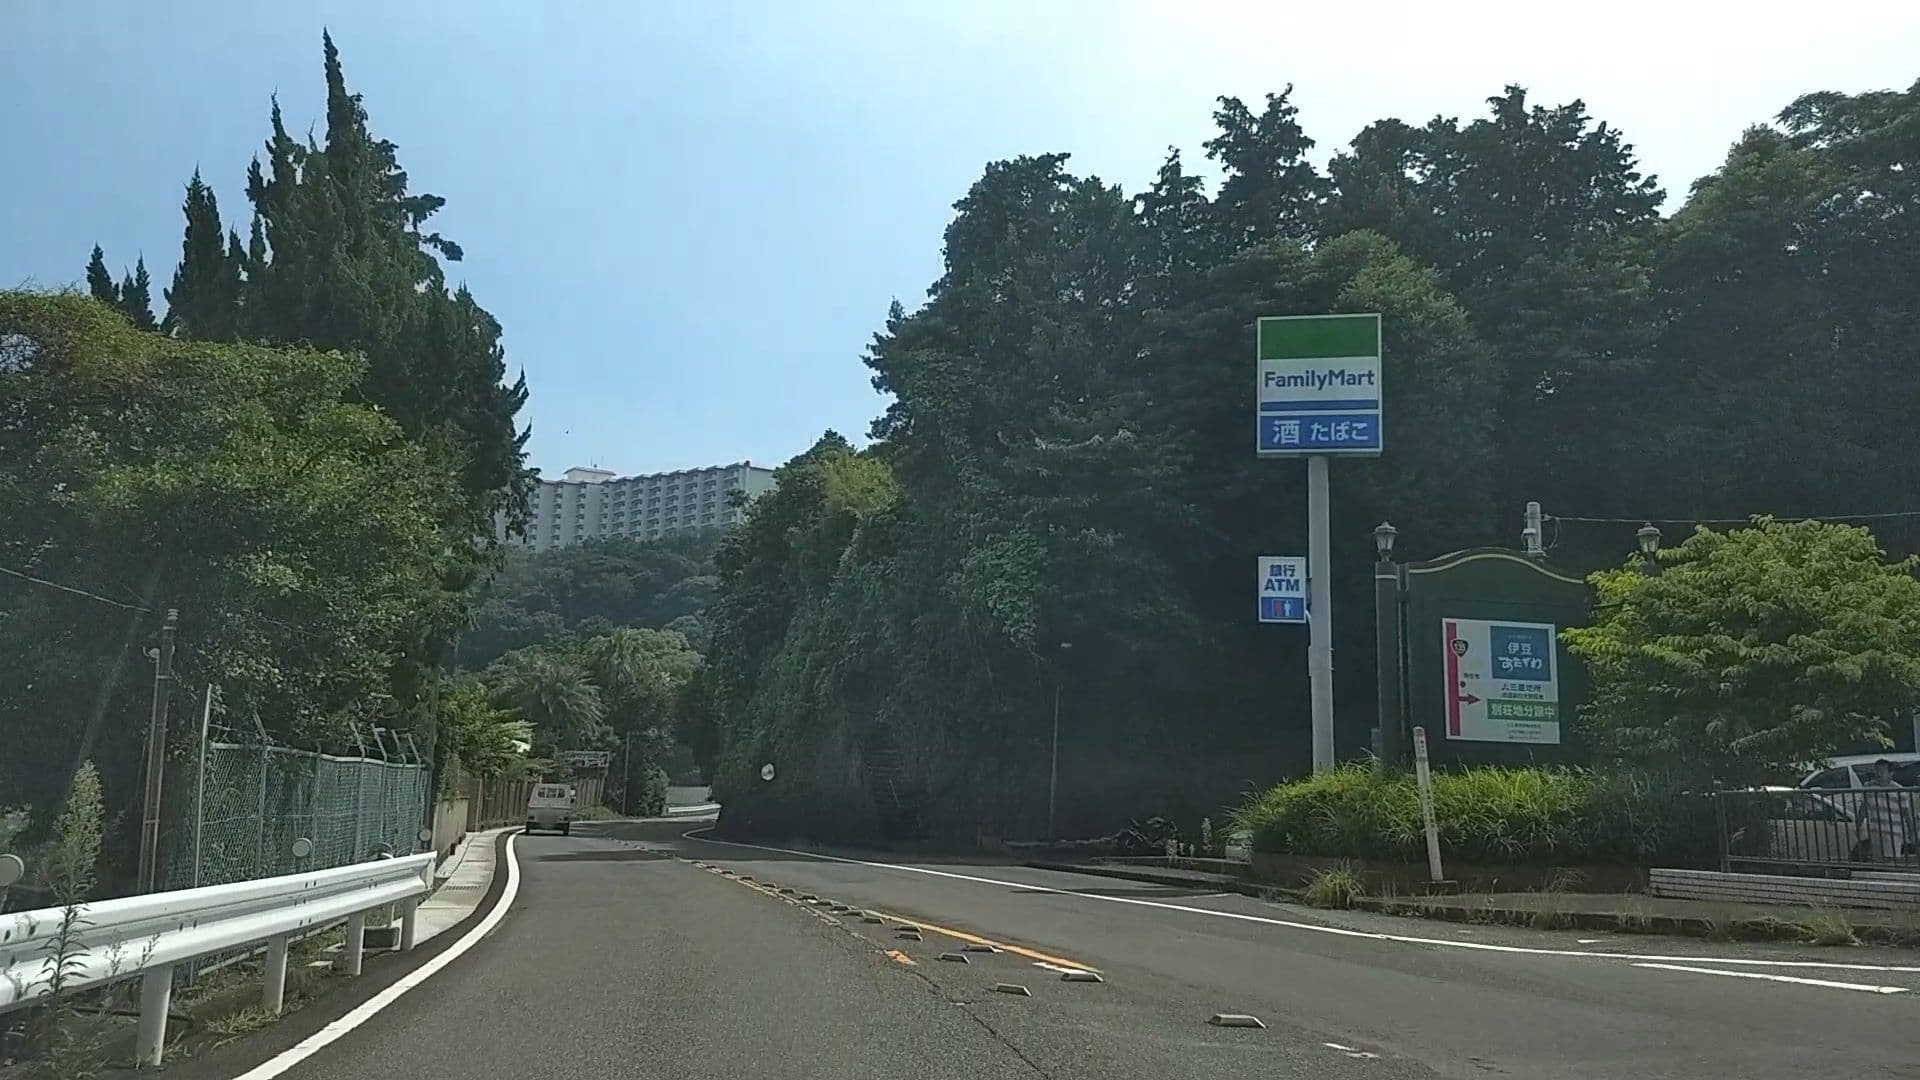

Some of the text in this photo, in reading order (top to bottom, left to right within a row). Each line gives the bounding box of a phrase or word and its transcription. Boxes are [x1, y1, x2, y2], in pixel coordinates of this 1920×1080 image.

[1264, 369, 1375, 390] FamilyMart
[1273, 420, 1369, 444] 酒 たばこ
[1270, 564, 1296, 577] 銀行
[1264, 578, 1300, 591] ATM
[1507, 642, 1532, 655] 伊豆
